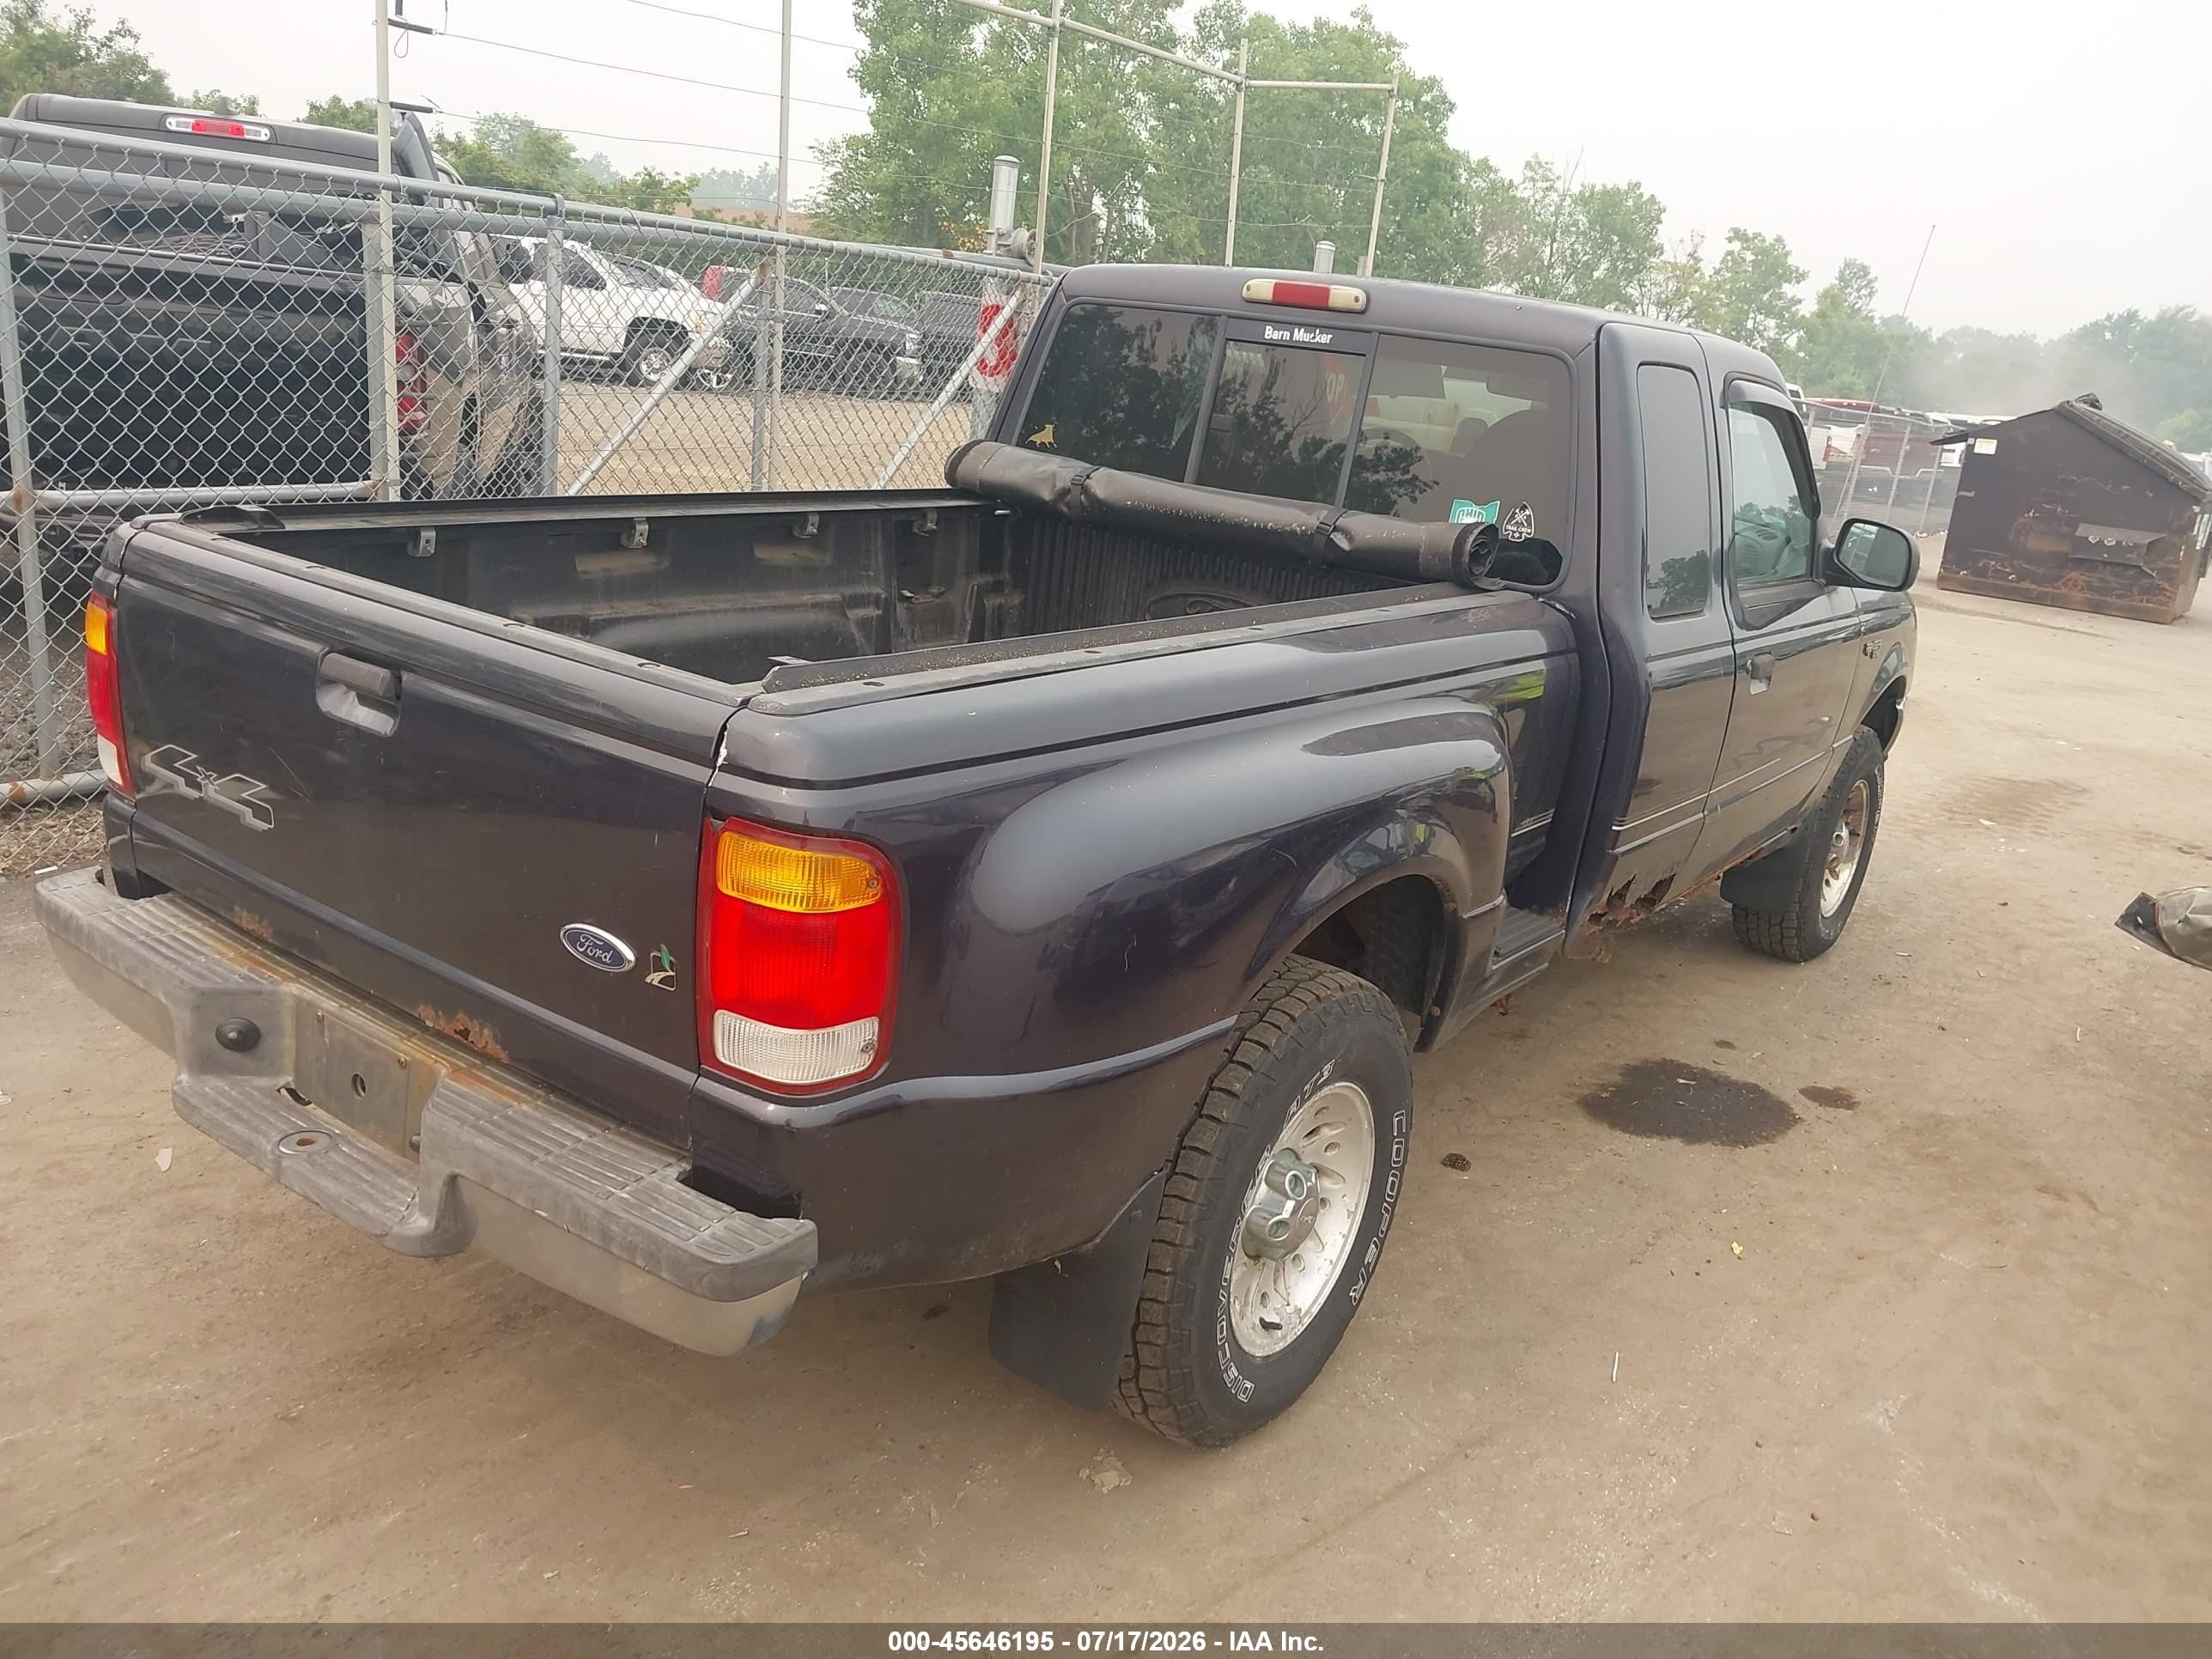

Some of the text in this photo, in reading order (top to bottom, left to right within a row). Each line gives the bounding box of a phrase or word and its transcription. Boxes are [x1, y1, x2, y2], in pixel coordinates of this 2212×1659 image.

[1264, 325, 1291, 341] Barn
[576, 933, 614, 963] Ford
[1349, 1109, 1407, 1306] COOPER
